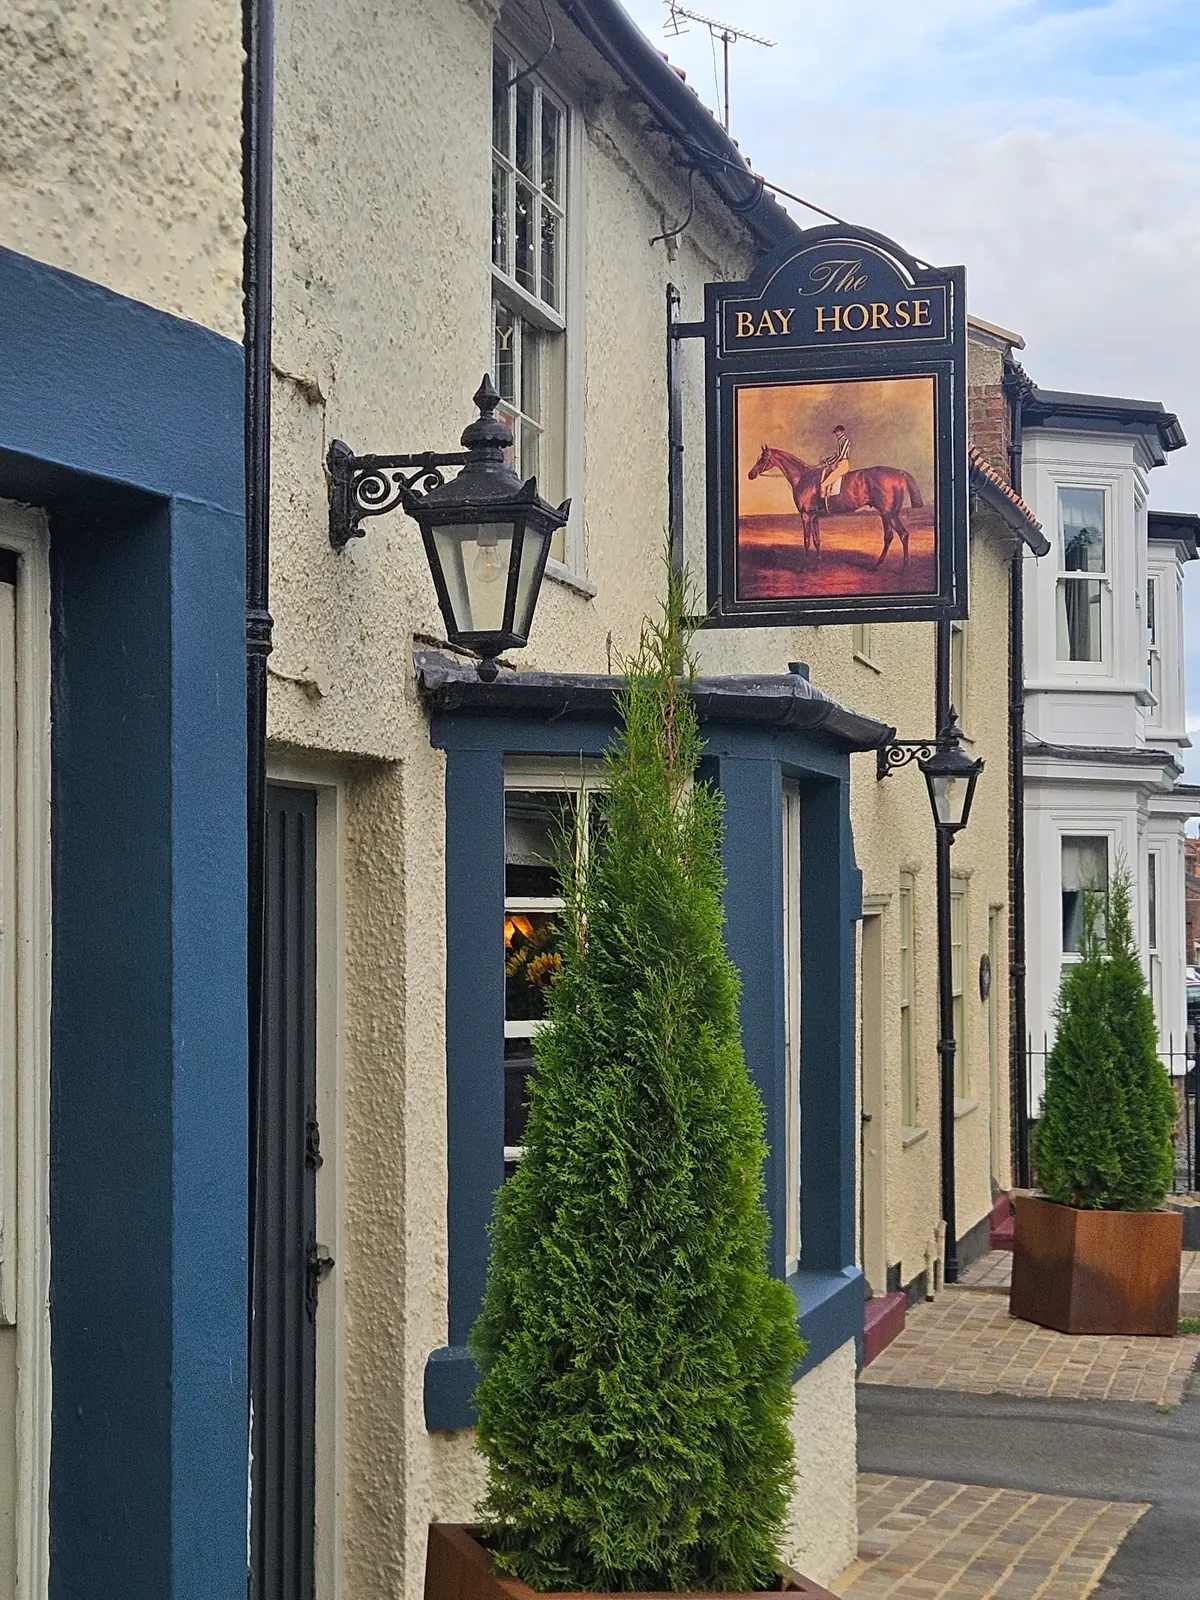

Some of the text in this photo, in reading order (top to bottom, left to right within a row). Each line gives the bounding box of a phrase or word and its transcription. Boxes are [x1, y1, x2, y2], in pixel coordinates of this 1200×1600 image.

[797, 257, 869, 296] The
[735, 299, 932, 338] BAY HORSE
